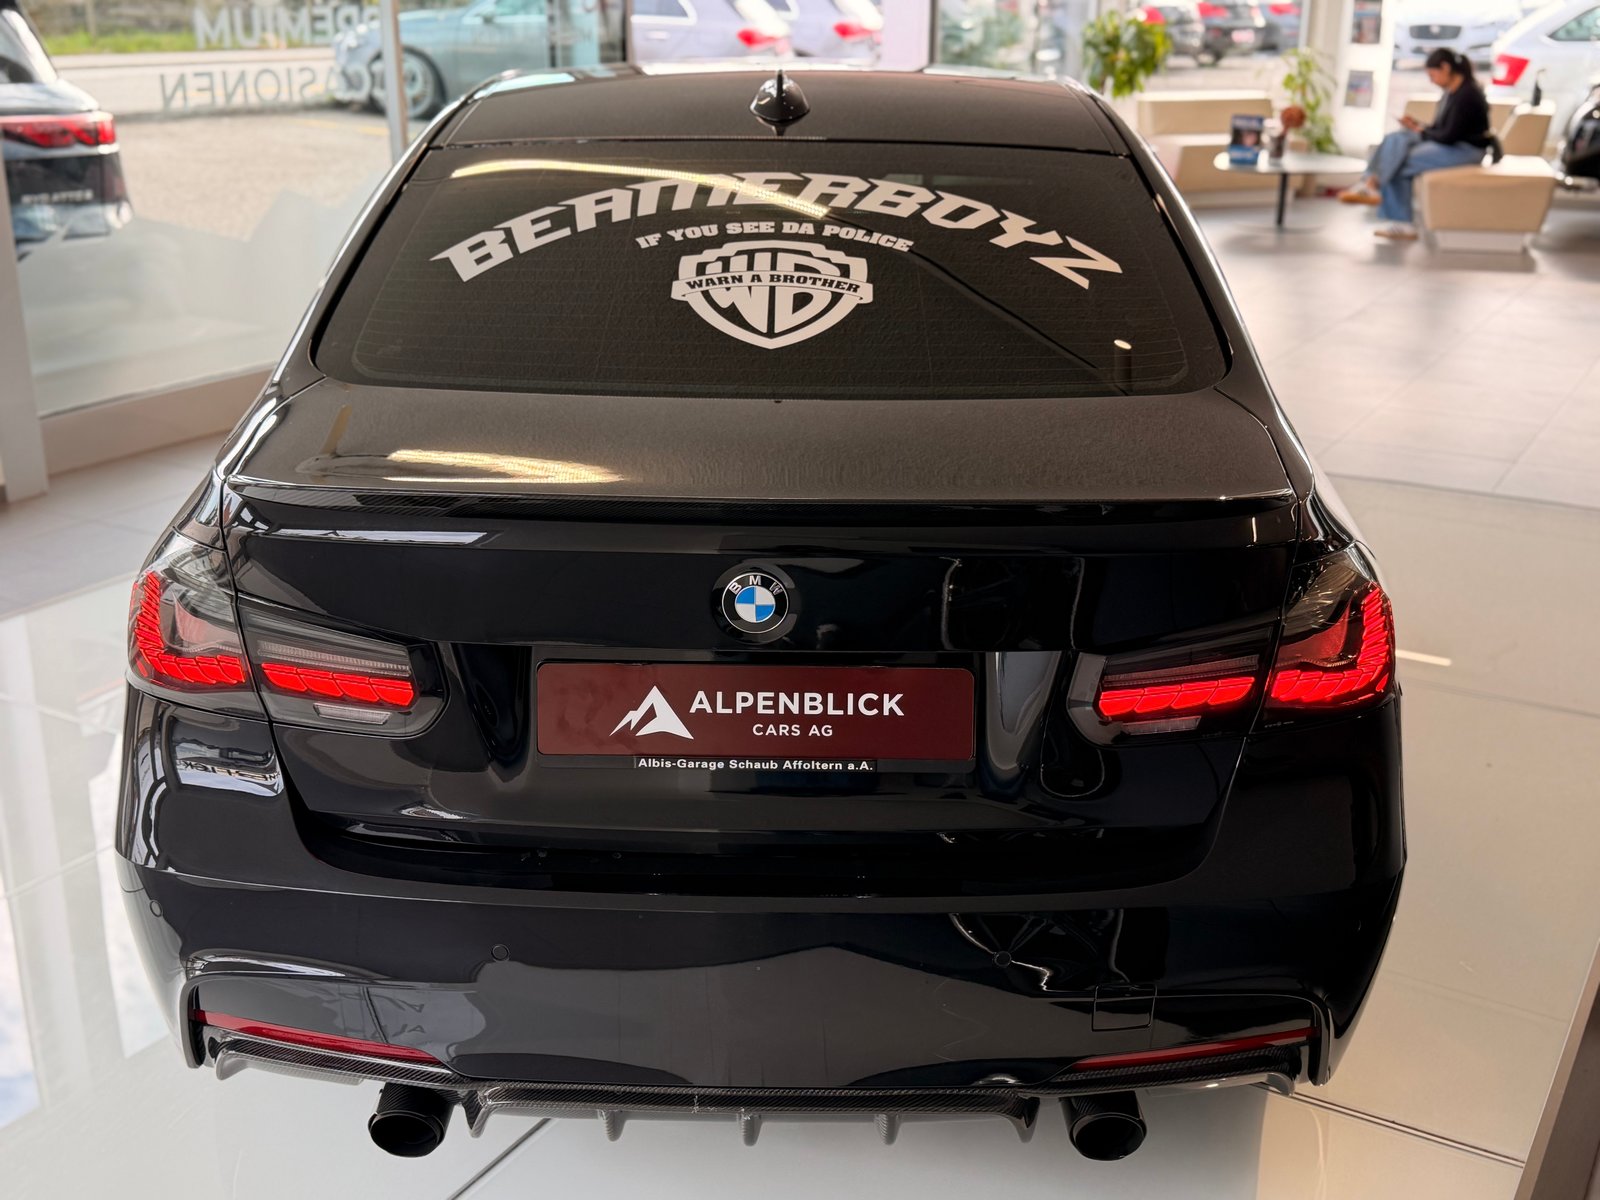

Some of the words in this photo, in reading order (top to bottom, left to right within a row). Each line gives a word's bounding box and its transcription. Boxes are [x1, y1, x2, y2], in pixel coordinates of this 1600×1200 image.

[429, 171, 1123, 290] BEAMERBOYZ
[635, 233, 662, 249] IF
[666, 224, 719, 242] YOU
[725, 221, 776, 235] SEE
[781, 221, 816, 235] DA
[822, 224, 914, 252] POLICE
[686, 274, 743, 290] WARN
[750, 274, 763, 283] A
[769, 274, 861, 293] BROTHER
[728, 575, 784, 596] BMW
[689, 690, 905, 716] ALPENBLICK
[752, 723, 801, 736] CARS
[808, 724, 833, 737] AG
[638, 758, 725, 771] Albis-Garage
[728, 759, 778, 769] Schaub
[782, 760, 843, 770] Affoltern
[847, 761, 873, 771] a.A.
